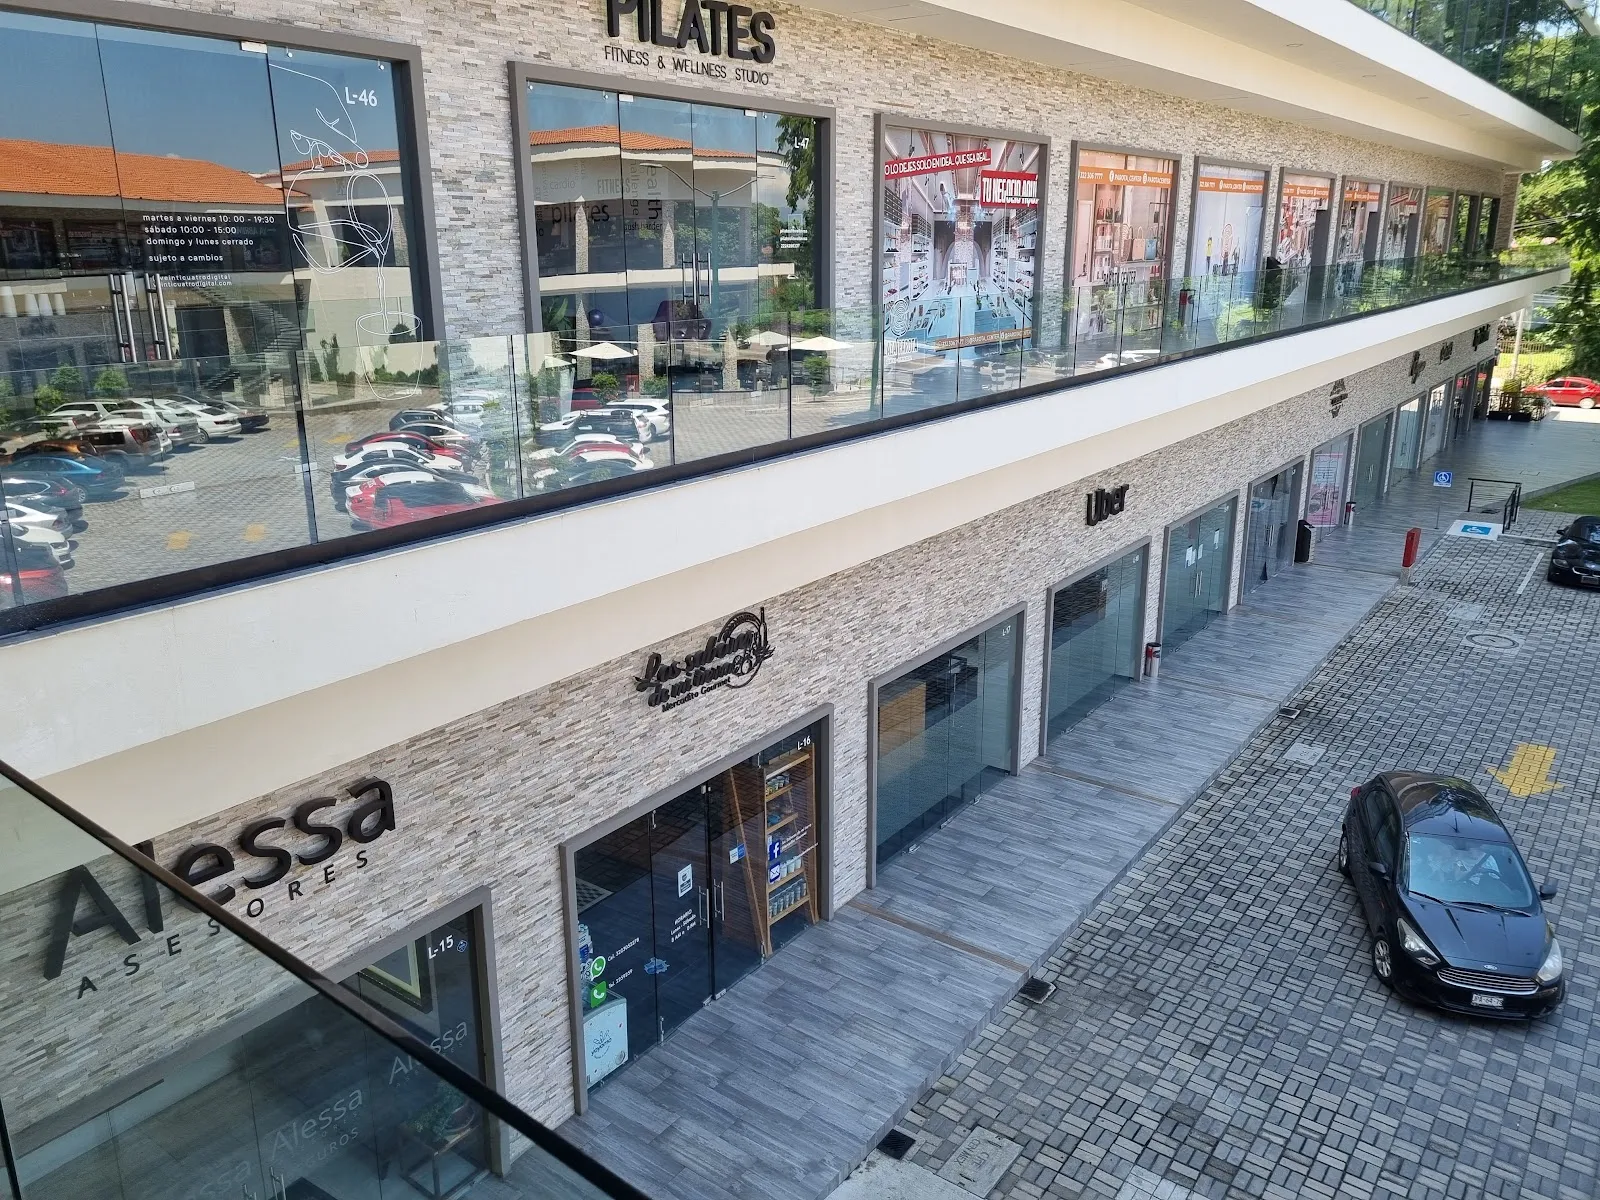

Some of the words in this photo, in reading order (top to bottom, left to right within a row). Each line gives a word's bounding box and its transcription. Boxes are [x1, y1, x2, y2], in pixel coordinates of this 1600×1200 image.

[606, 0, 776, 64] PILATES
[604, 45, 650, 67] FITNESS
[657, 55, 666, 69] &
[672, 57, 727, 79] WELLNESS
[735, 68, 769, 86] STUDIO
[345, 86, 378, 107] L-46
[597, 179, 631, 195] FITNES
[646, 165, 662, 220] ealth
[143, 214, 174, 222] martes
[185, 214, 217, 223] viernes
[219, 215, 231, 223] 10:
[233, 215, 245, 223] 00
[253, 215, 275, 223] 19:30
[552, 200, 610, 224] piltes
[144, 225, 178, 233] sábado
[180, 225, 205, 234] 10:00
[213, 226, 237, 234] 15:00
[146, 238, 185, 247] domingo
[188, 239, 193, 247] y
[221, 238, 254, 246] cerrado
[148, 253, 177, 263] sujeto
[187, 253, 224, 262] cambios
[153, 280, 233, 288] vinticuatrodigital.com
[1086, 484, 1129, 527] Uber
[661, 691, 700, 713] Mercadito
[700, 677, 732, 695] Gourmet
[796, 735, 811, 750] L-16
[43, 775, 396, 981] Alessa
[428, 934, 454, 960] L-15
[389, 1020, 467, 1085] Alssa
[269, 1088, 363, 1162] Alessa
